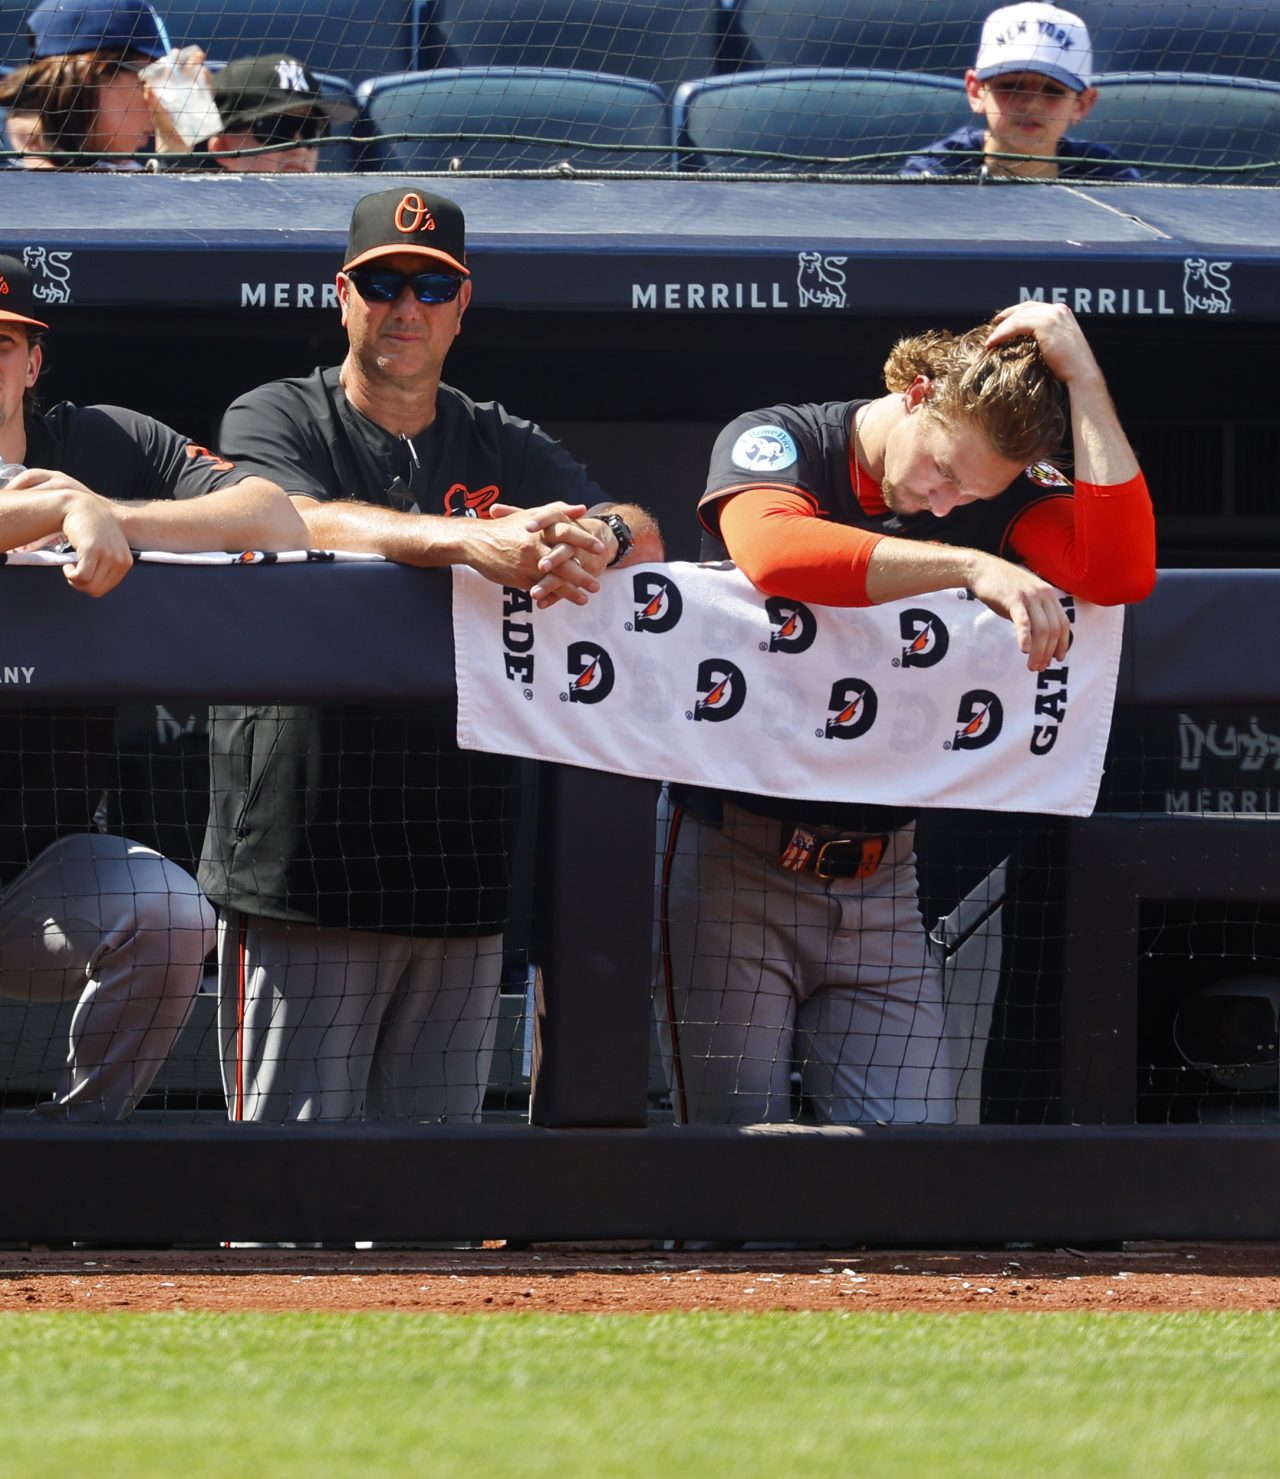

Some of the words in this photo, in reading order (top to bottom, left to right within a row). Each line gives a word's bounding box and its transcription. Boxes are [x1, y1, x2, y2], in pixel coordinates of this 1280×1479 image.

[996, 20, 1027, 47] NEW
[1036, 19, 1074, 52] YORK
[394, 193, 437, 234] O's
[631, 283, 789, 309] MERRILL
[1019, 286, 1175, 314] MERRILL
[1166, 790, 1280, 813] MERRI
